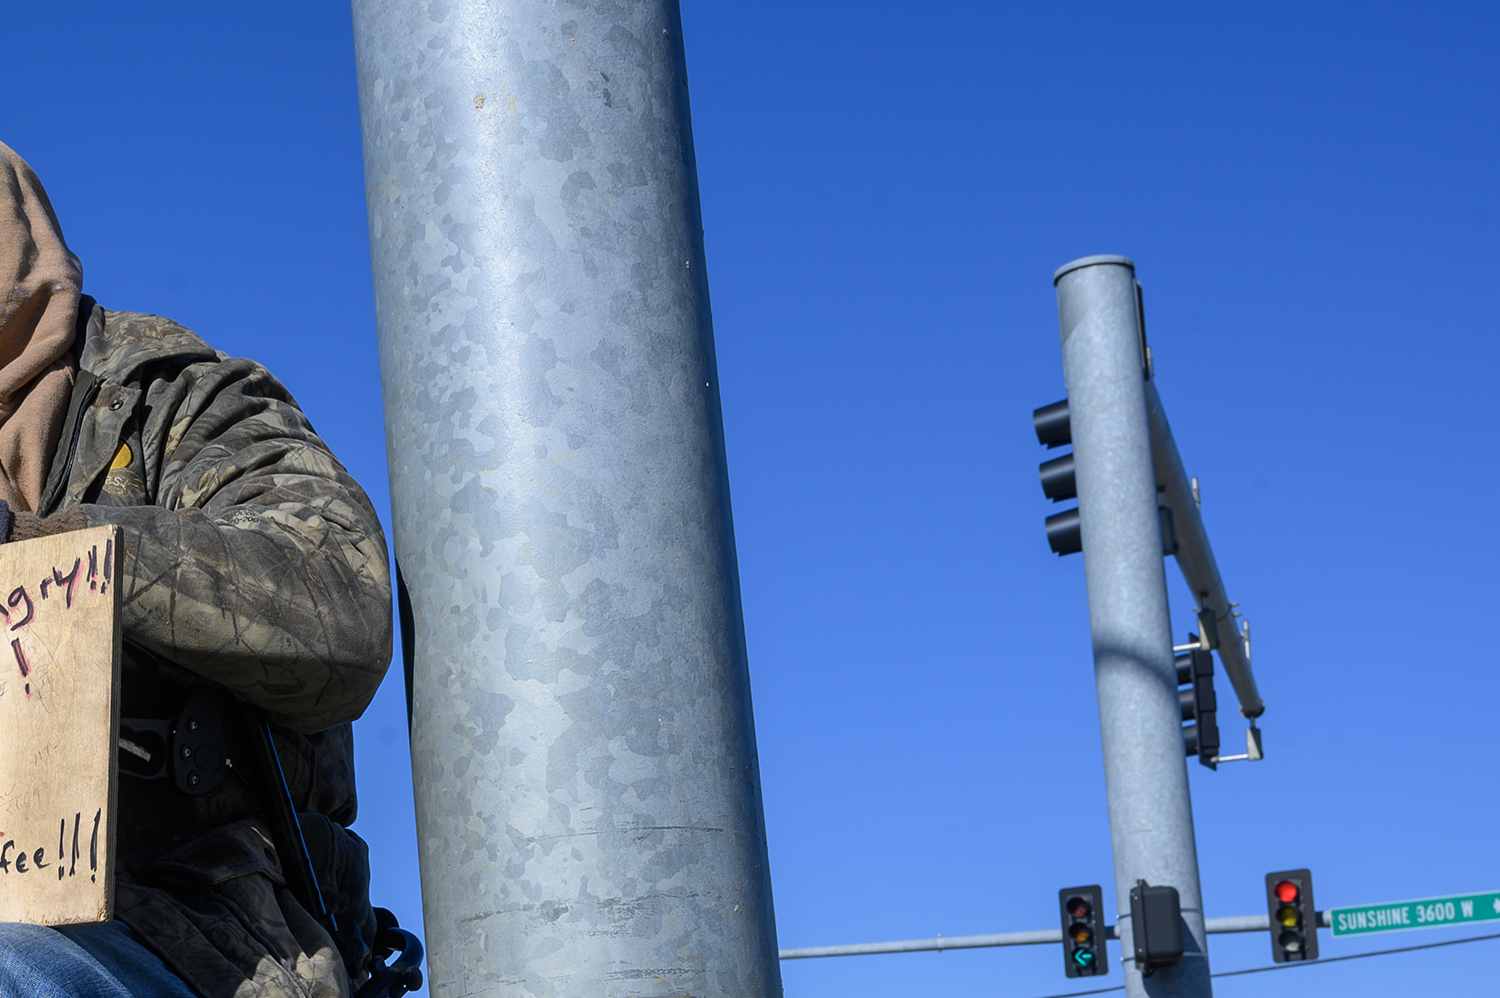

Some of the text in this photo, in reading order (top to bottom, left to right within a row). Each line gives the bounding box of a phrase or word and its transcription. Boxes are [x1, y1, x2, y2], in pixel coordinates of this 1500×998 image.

[1338, 900, 1474, 931] SUNSHINE 3600 W
